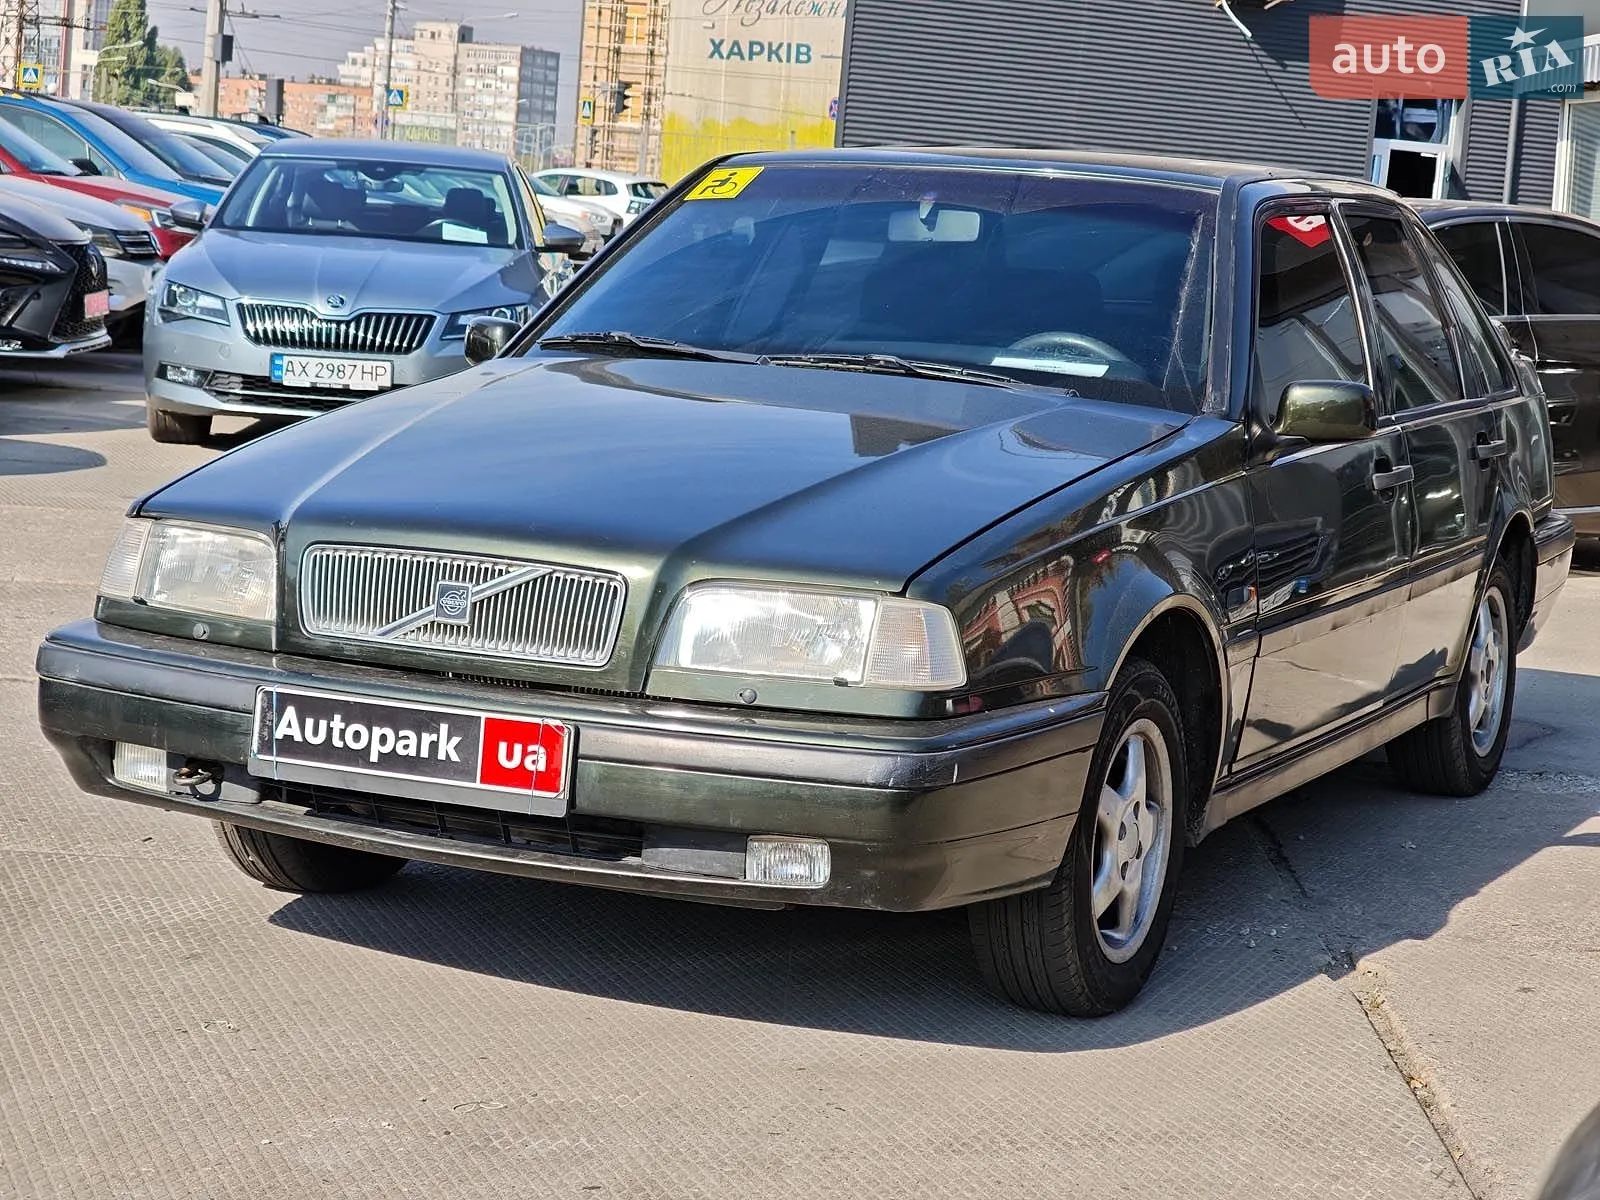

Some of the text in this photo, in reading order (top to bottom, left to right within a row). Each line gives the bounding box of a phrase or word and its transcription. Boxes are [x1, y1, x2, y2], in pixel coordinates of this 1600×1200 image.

[702, 0, 847, 27] Незалежн
[708, 38, 812, 64] ХАРКІВ
[284, 360, 387, 382] AX 2987 HP
[274, 705, 547, 773] Autopark ua
